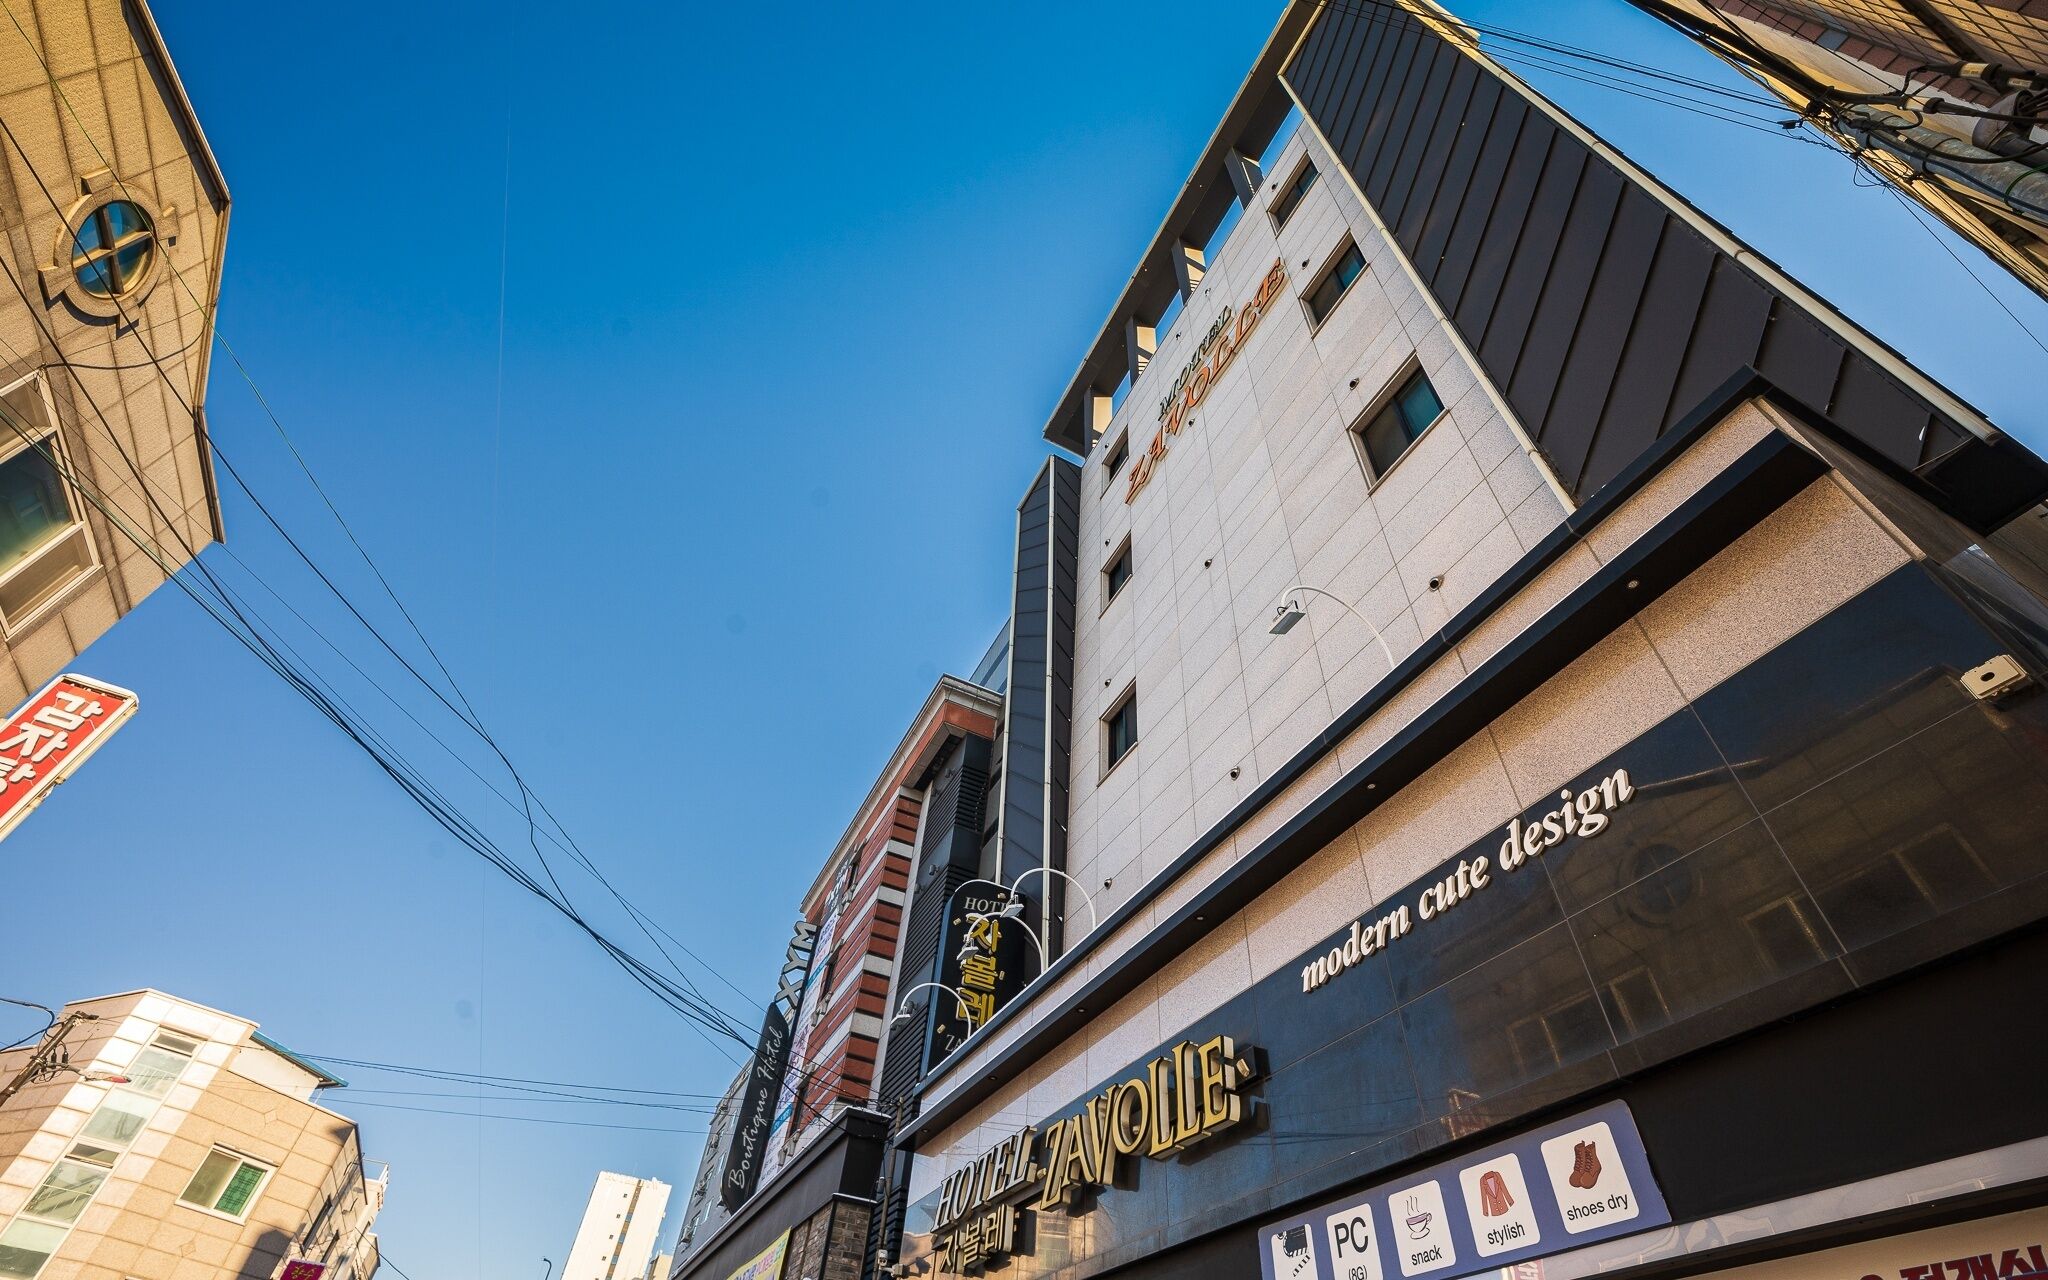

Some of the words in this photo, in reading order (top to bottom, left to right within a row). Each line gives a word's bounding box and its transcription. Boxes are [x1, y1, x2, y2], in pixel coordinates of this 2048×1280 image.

[1125, 257, 1288, 505] ZAVOLLE
[1301, 904, 1412, 993] modern
[1419, 855, 1490, 921] cute
[1499, 768, 1637, 872] design
[775, 920, 818, 1009] XYM
[728, 1086, 768, 1192] Boutique
[756, 1024, 783, 1082] Hotel
[930, 1125, 1038, 1233] HOTEL
[1040, 1035, 1240, 1211] ZAVOLLE
[939, 1203, 1012, 1274] 자볼레
[1334, 1217, 1368, 1258] PC
[1487, 1222, 1525, 1246] stylish
[1567, 1201, 1605, 1221] shoes
[1607, 1194, 1629, 1210] dry
[1411, 1245, 1442, 1266] snack
